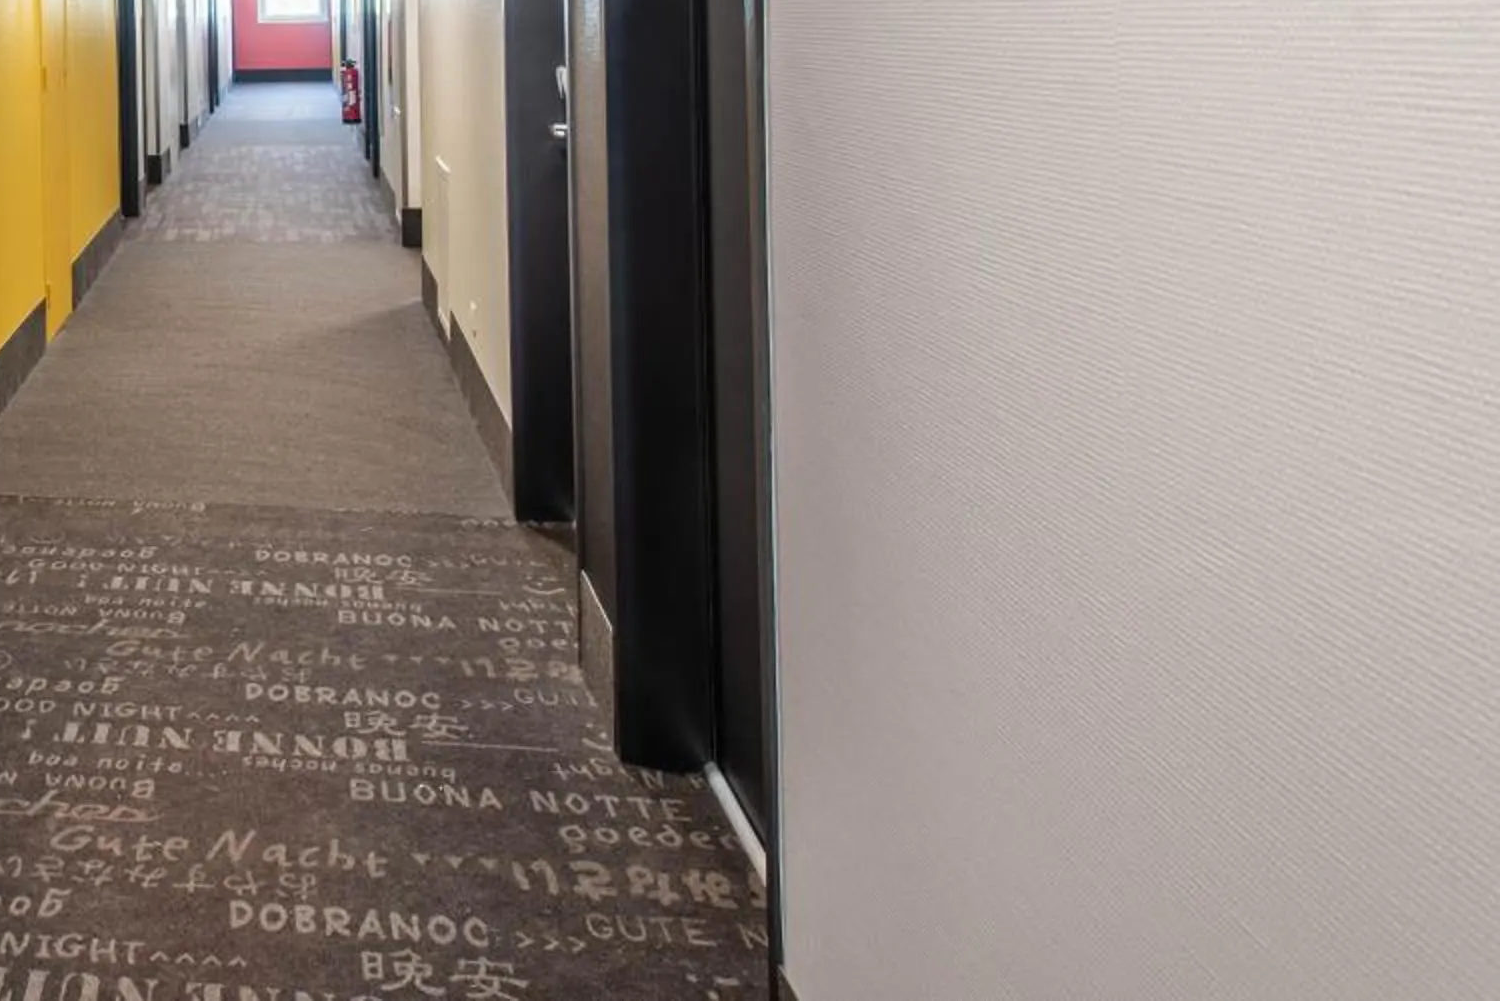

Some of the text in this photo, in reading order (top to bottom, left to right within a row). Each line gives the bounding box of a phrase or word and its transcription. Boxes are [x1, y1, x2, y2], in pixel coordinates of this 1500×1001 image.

[255, 549, 412, 567] DOBRANOC
[337, 610, 458, 631] BUONA
[72, 701, 183, 721] NIGHT
[245, 682, 441, 710] DOBRANOC
[52, 721, 192, 750] NUIT
[212, 729, 411, 762] BONNE
[46, 772, 156, 799] BUONA
[350, 778, 692, 823] BUONA NOTTE
[51, 825, 388, 879] Gute Nacht
[229, 900, 490, 949] DOBRANOC
[585, 913, 717, 948] GUTE
[1, 931, 146, 965] NIGHT
